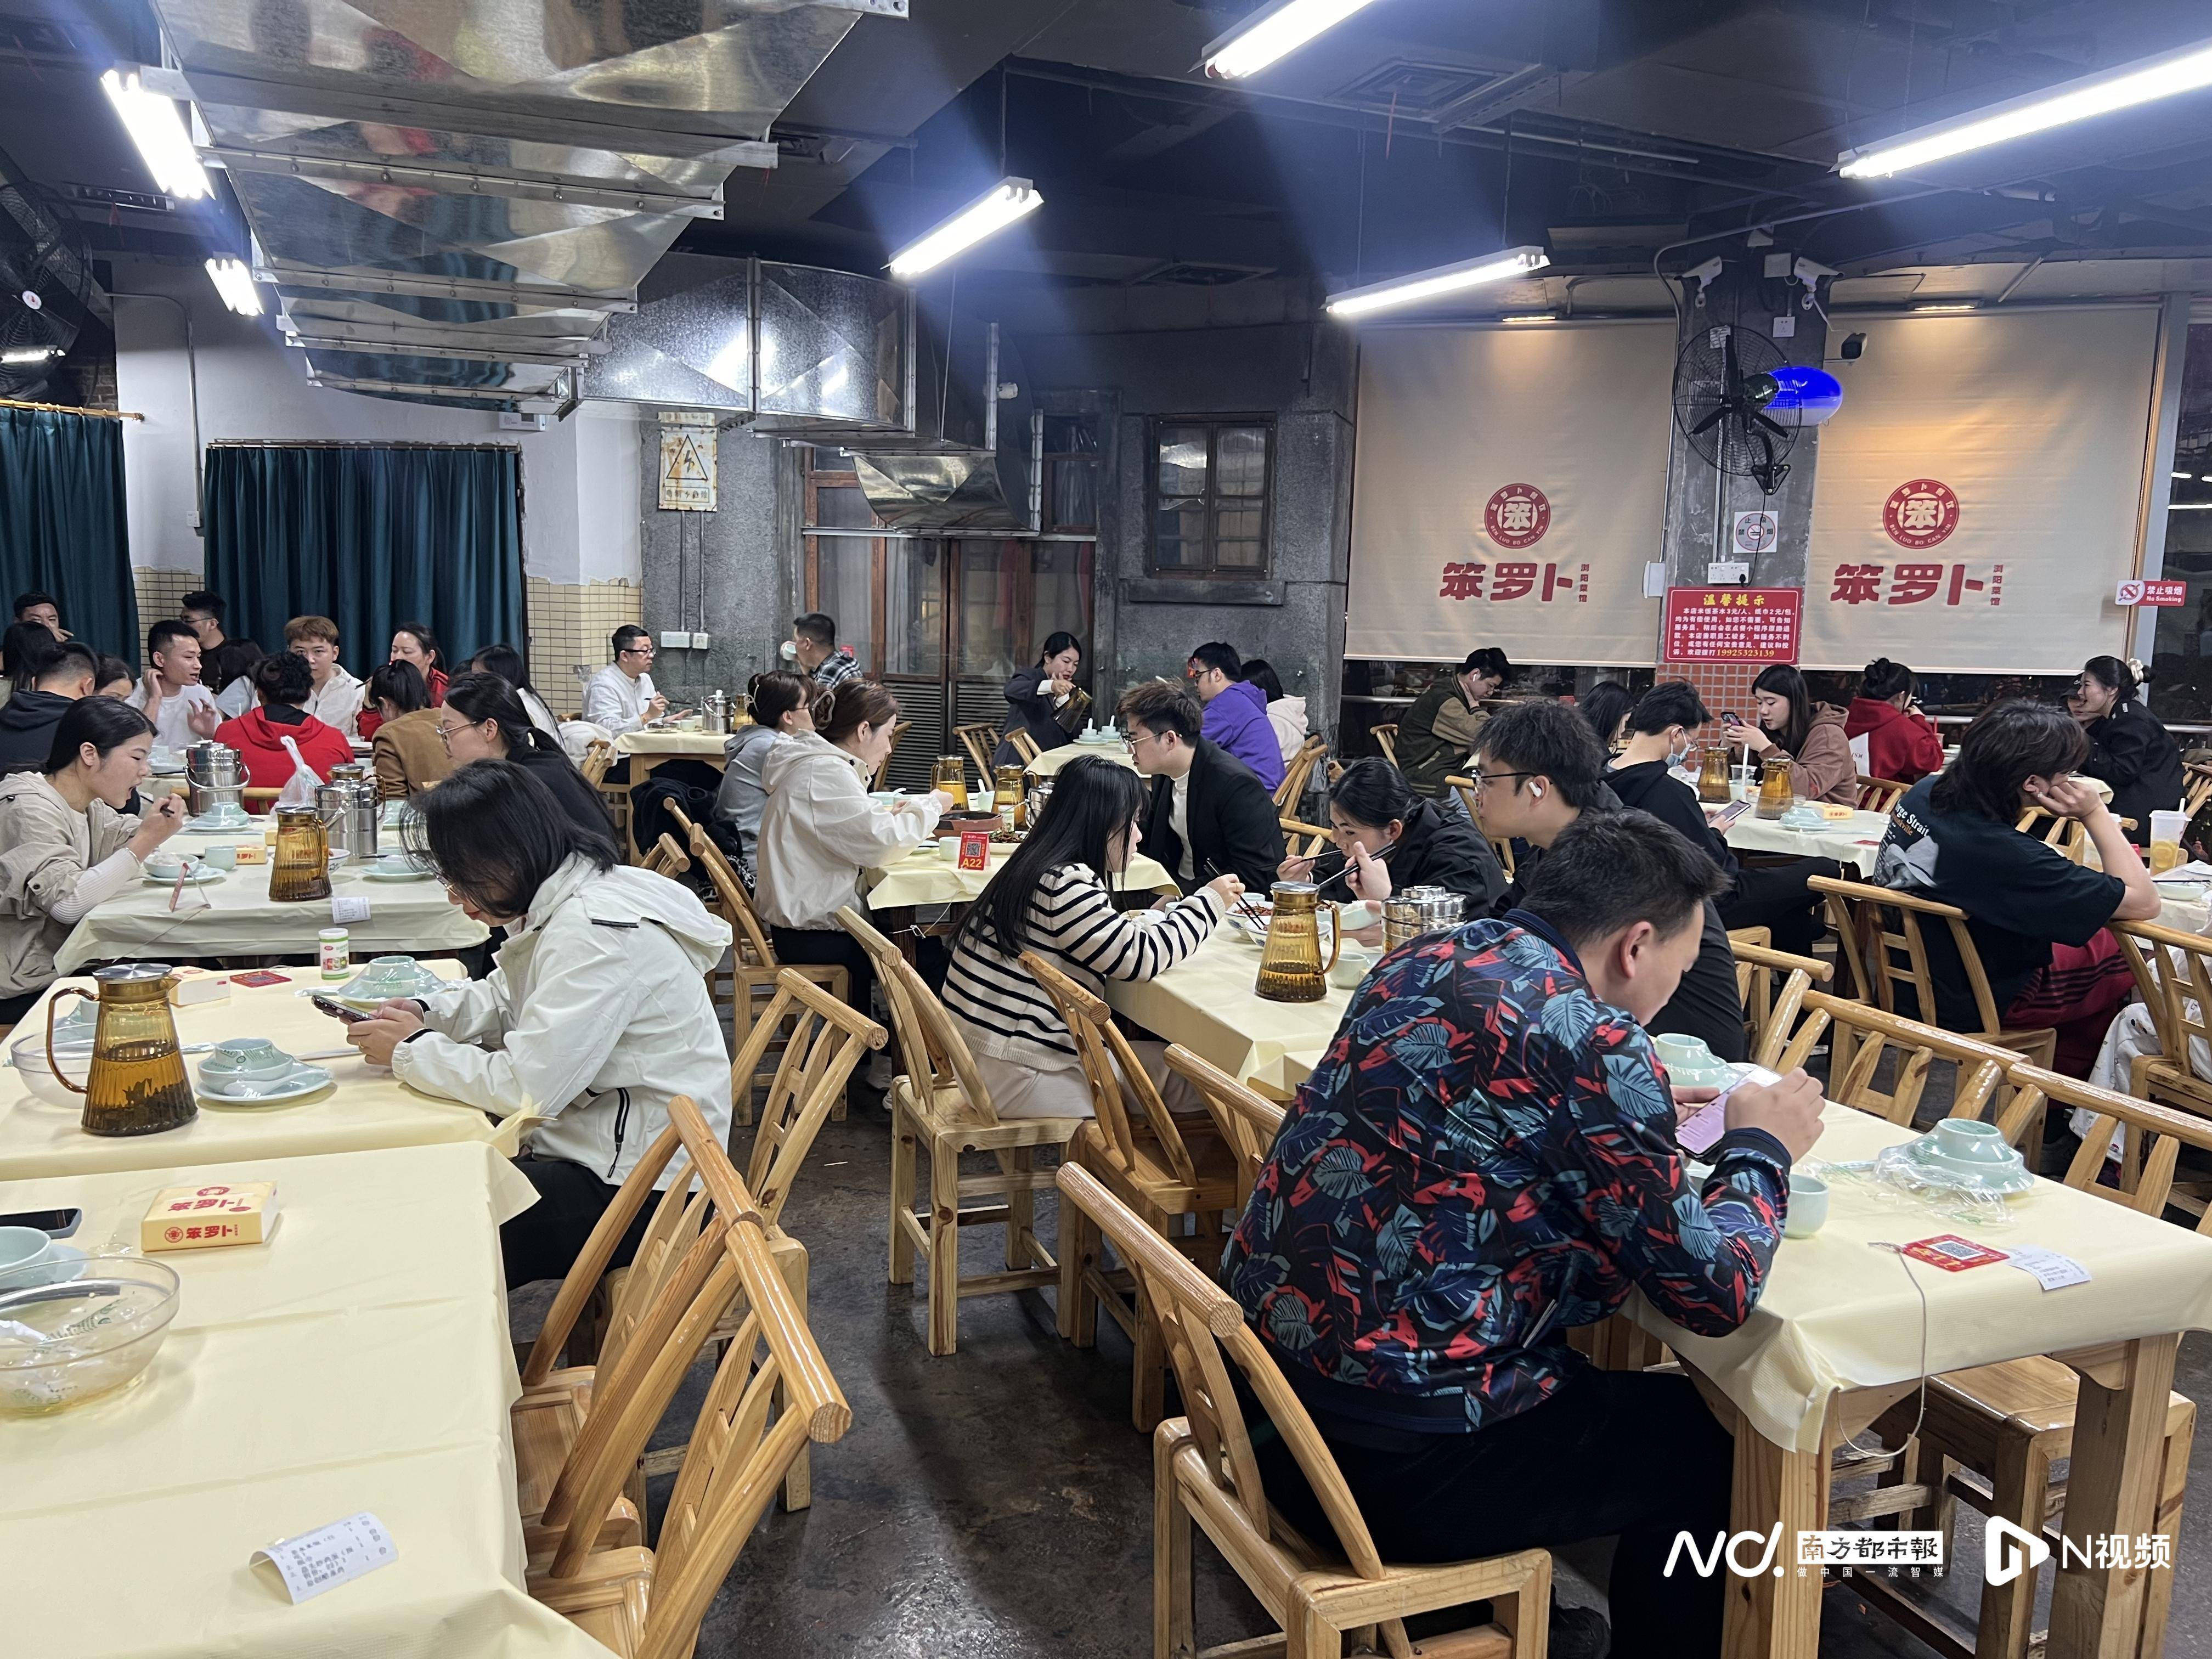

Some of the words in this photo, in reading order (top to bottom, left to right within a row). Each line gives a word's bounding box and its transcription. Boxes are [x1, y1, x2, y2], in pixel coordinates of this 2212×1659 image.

[1503, 503, 1532, 530] 笨
[1904, 500, 1938, 529] 笨
[1927, 535, 1940, 543] CAN
[1440, 562, 1573, 601] 笨罗卜
[1830, 564, 1983, 605] 笨罗卜
[2147, 585, 2182, 595] 禁止吸烟
[1703, 594, 1764, 606] 温馨提示
[1906, 814, 1929, 837] Strait
[962, 858, 981, 867] A22
[168, 1199, 234, 1211] 笨罗卜
[186, 1225, 232, 1239] 笨罗卜
